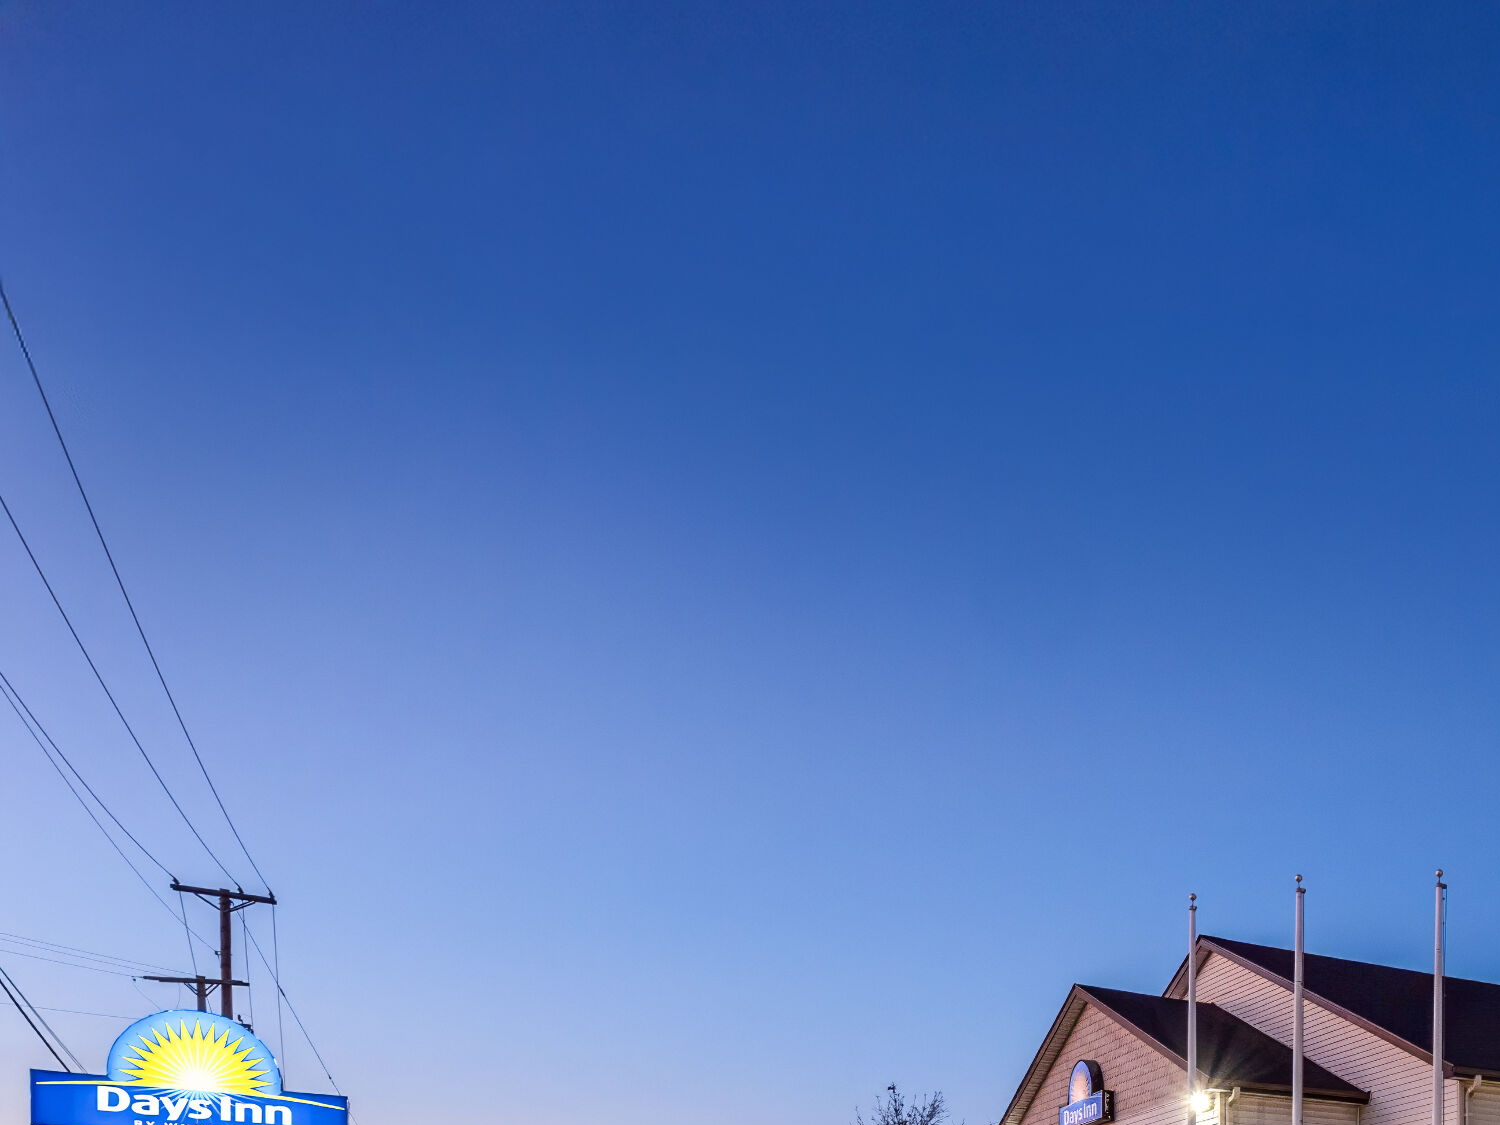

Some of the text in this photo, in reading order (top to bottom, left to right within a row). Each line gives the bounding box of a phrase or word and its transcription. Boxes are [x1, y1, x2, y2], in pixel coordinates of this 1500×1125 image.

[97, 1085, 293, 1125] Days Inn
[1064, 1103, 1097, 1125] Days Inn
